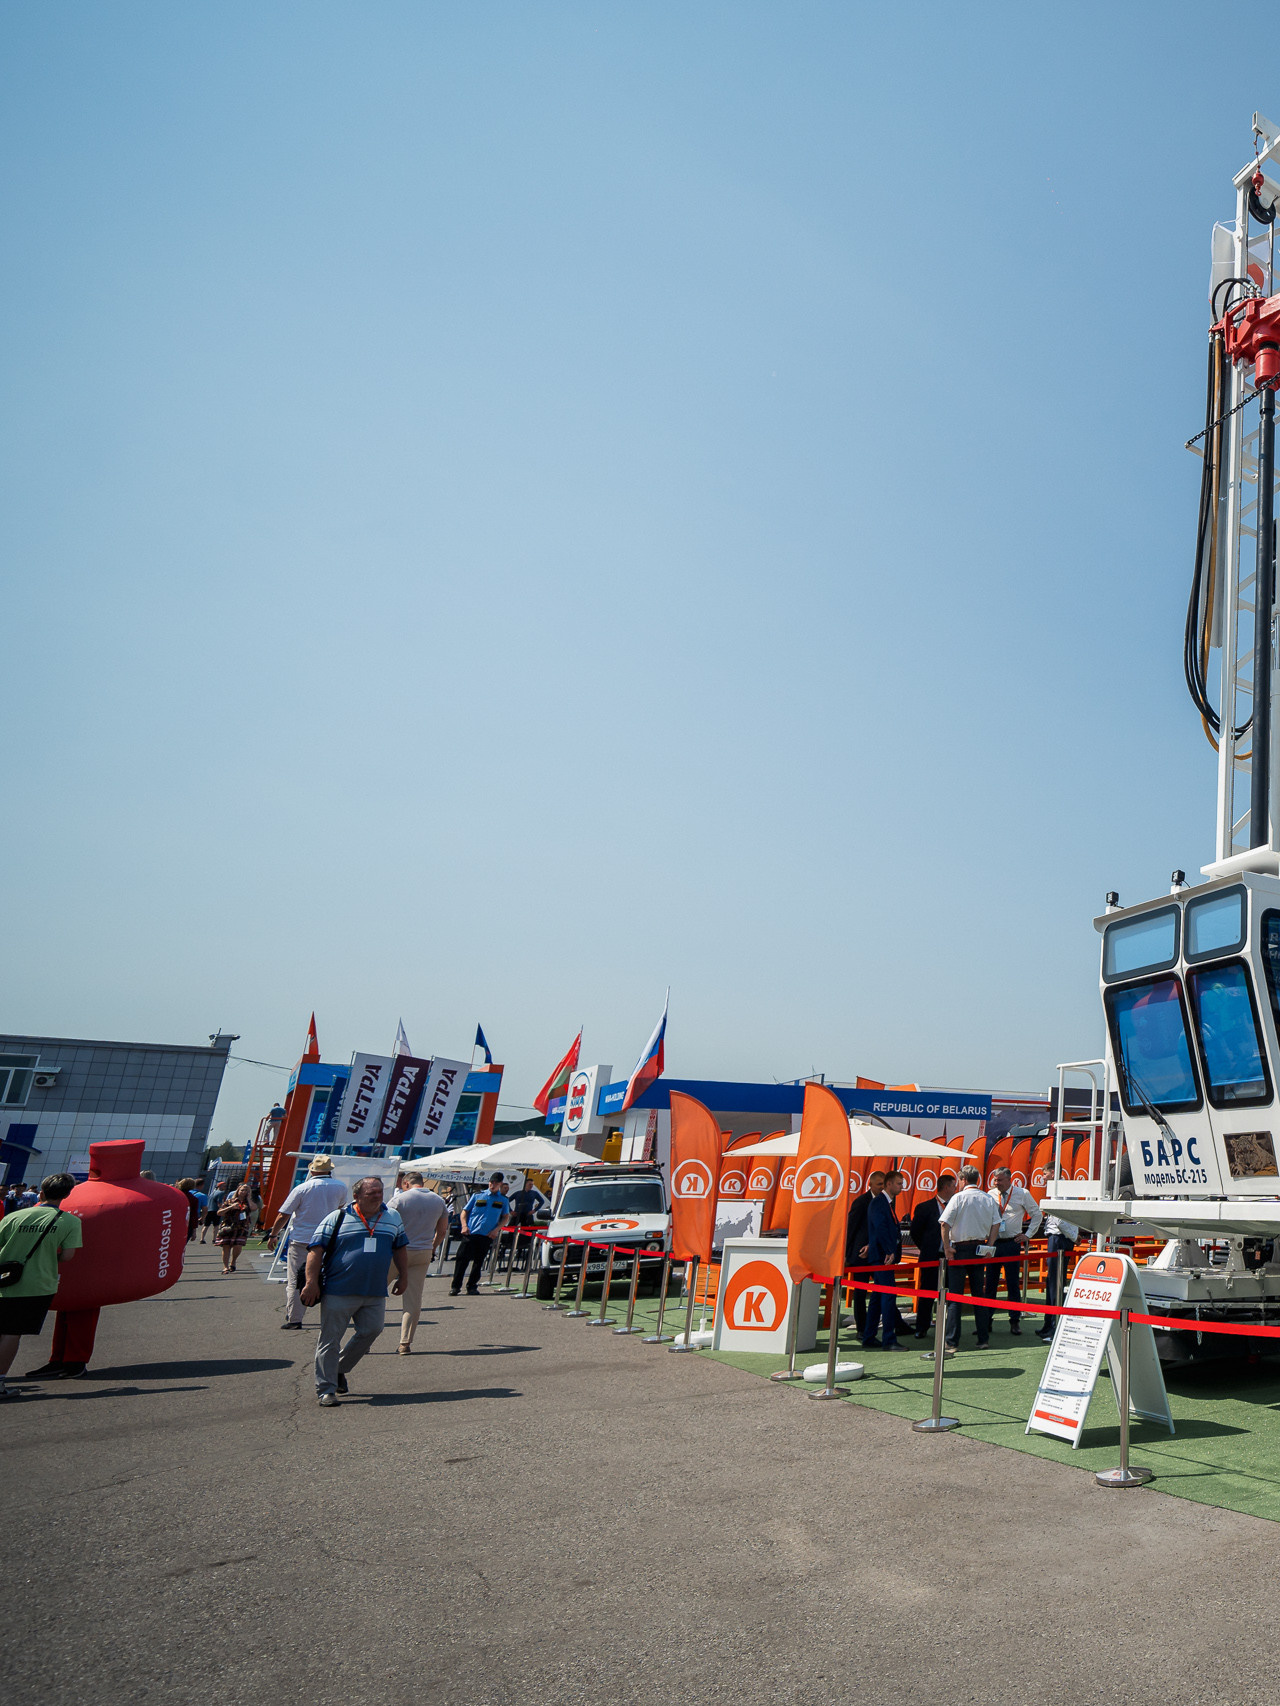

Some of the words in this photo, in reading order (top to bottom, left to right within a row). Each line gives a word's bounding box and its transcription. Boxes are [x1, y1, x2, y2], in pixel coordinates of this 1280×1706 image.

[346, 1064, 382, 1134] ЧЕТРА
[381, 1066, 420, 1135] ЧЕТРА
[423, 1068, 458, 1136] ЧЕТРА
[873, 1103, 924, 1113] REPUBLIC
[926, 1104, 940, 1114] OF
[942, 1105, 987, 1115] BELARUS
[1140, 1137, 1201, 1167] БАРС
[1144, 1172, 1175, 1187] модель
[1175, 1168, 1208, 1184] БС-215
[158, 1209, 172, 1278] epotos.ru
[1073, 1288, 1112, 1302] БС-215-02
